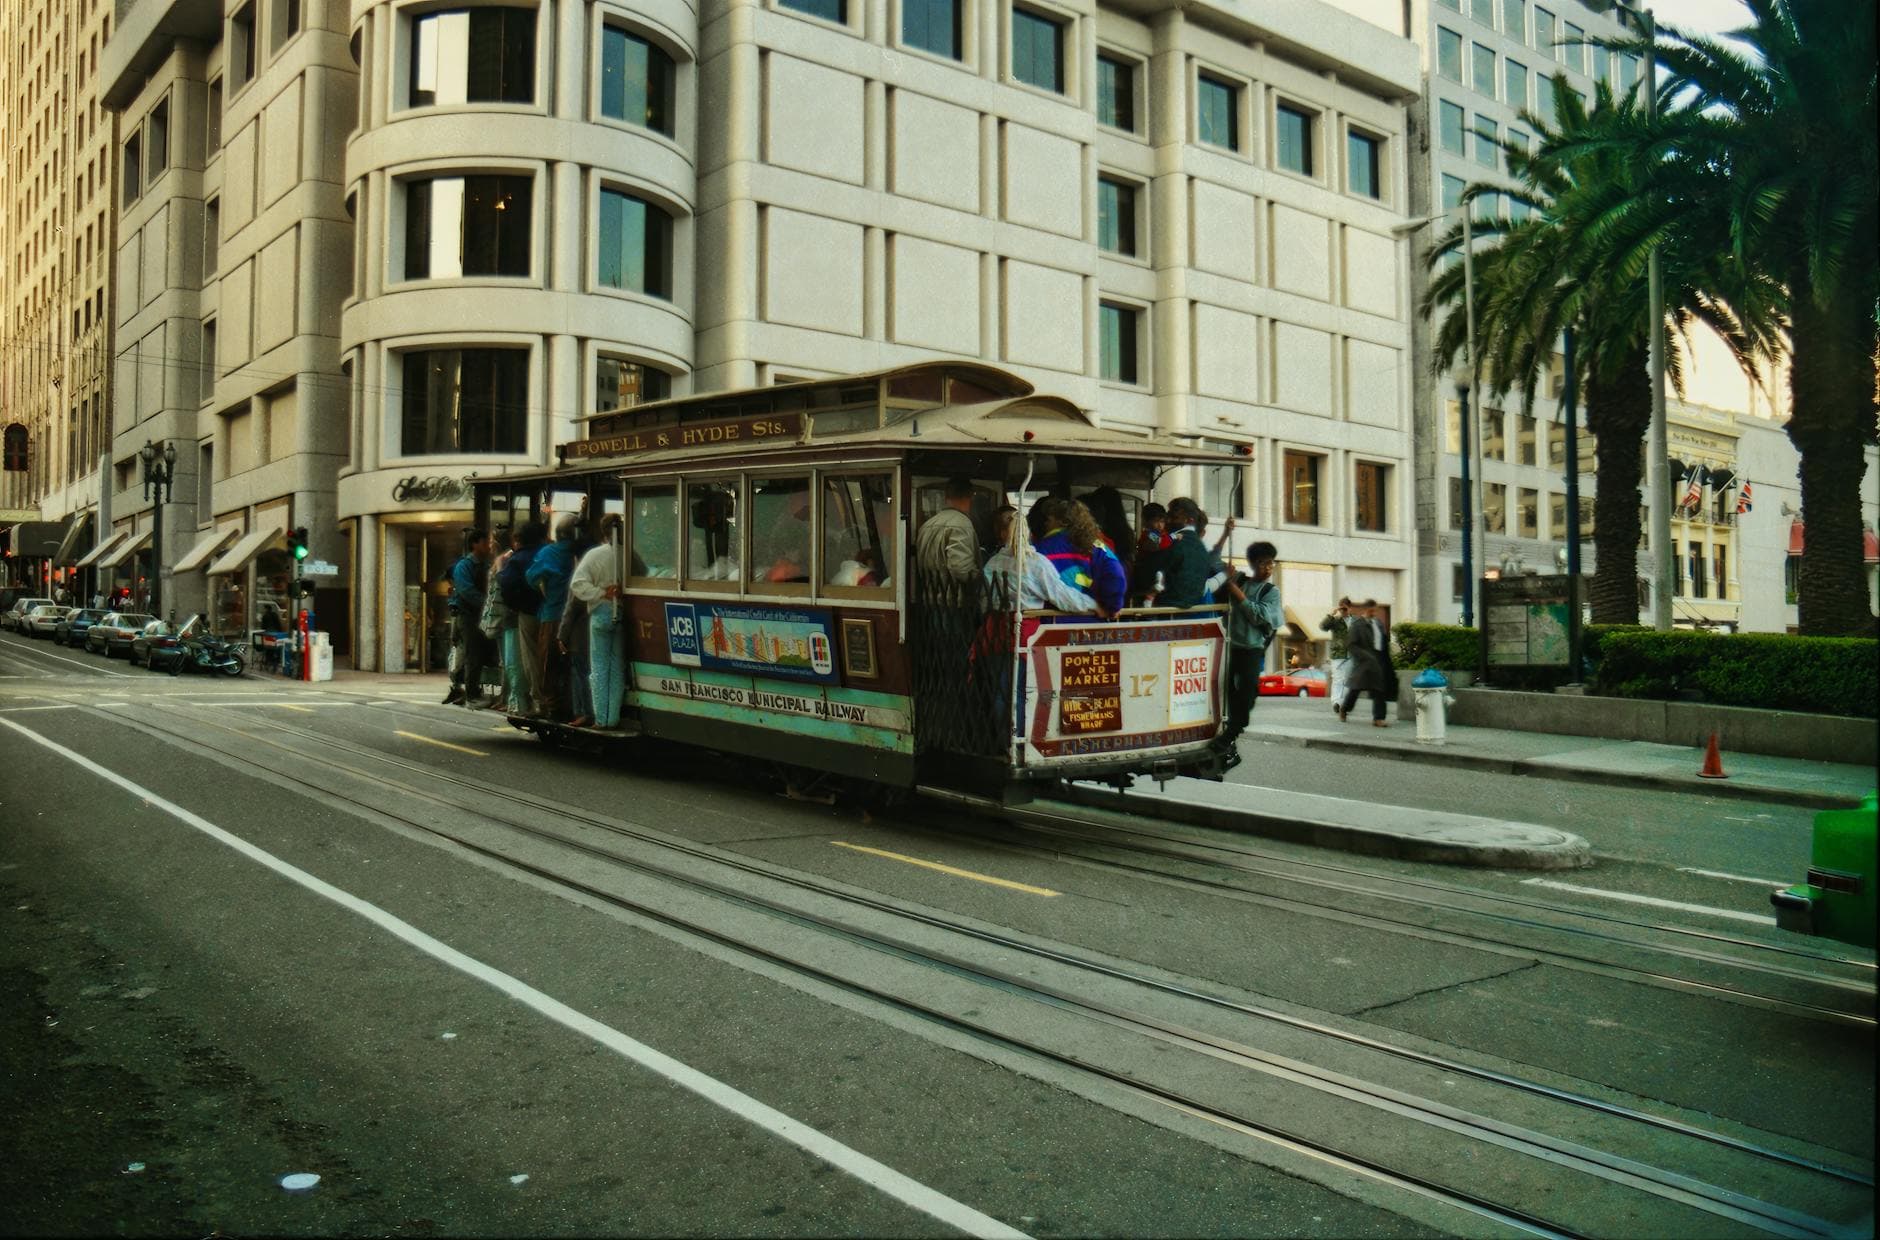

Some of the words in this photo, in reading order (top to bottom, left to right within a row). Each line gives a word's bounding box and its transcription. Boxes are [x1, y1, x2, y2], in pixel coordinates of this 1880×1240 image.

[576, 435, 647, 456] POWELL
[656, 432, 670, 447] &
[683, 424, 740, 445] HYDE
[752, 420, 787, 436] Sts.
[671, 616, 694, 636] JCB
[672, 637, 697, 649] PLAZA
[1065, 655, 1117, 667] POWELL
[1079, 665, 1106, 674] AND
[1174, 656, 1207, 675] RICE
[1064, 673, 1118, 686] MARKET
[1129, 673, 1159, 698] 17
[1173, 677, 1207, 695] RONI
[661, 679, 682, 693] SAN
[685, 683, 744, 703] FRANCISCO
[748, 691, 811, 713] MUNICIPAL
[815, 701, 866, 722] RAILWAY
